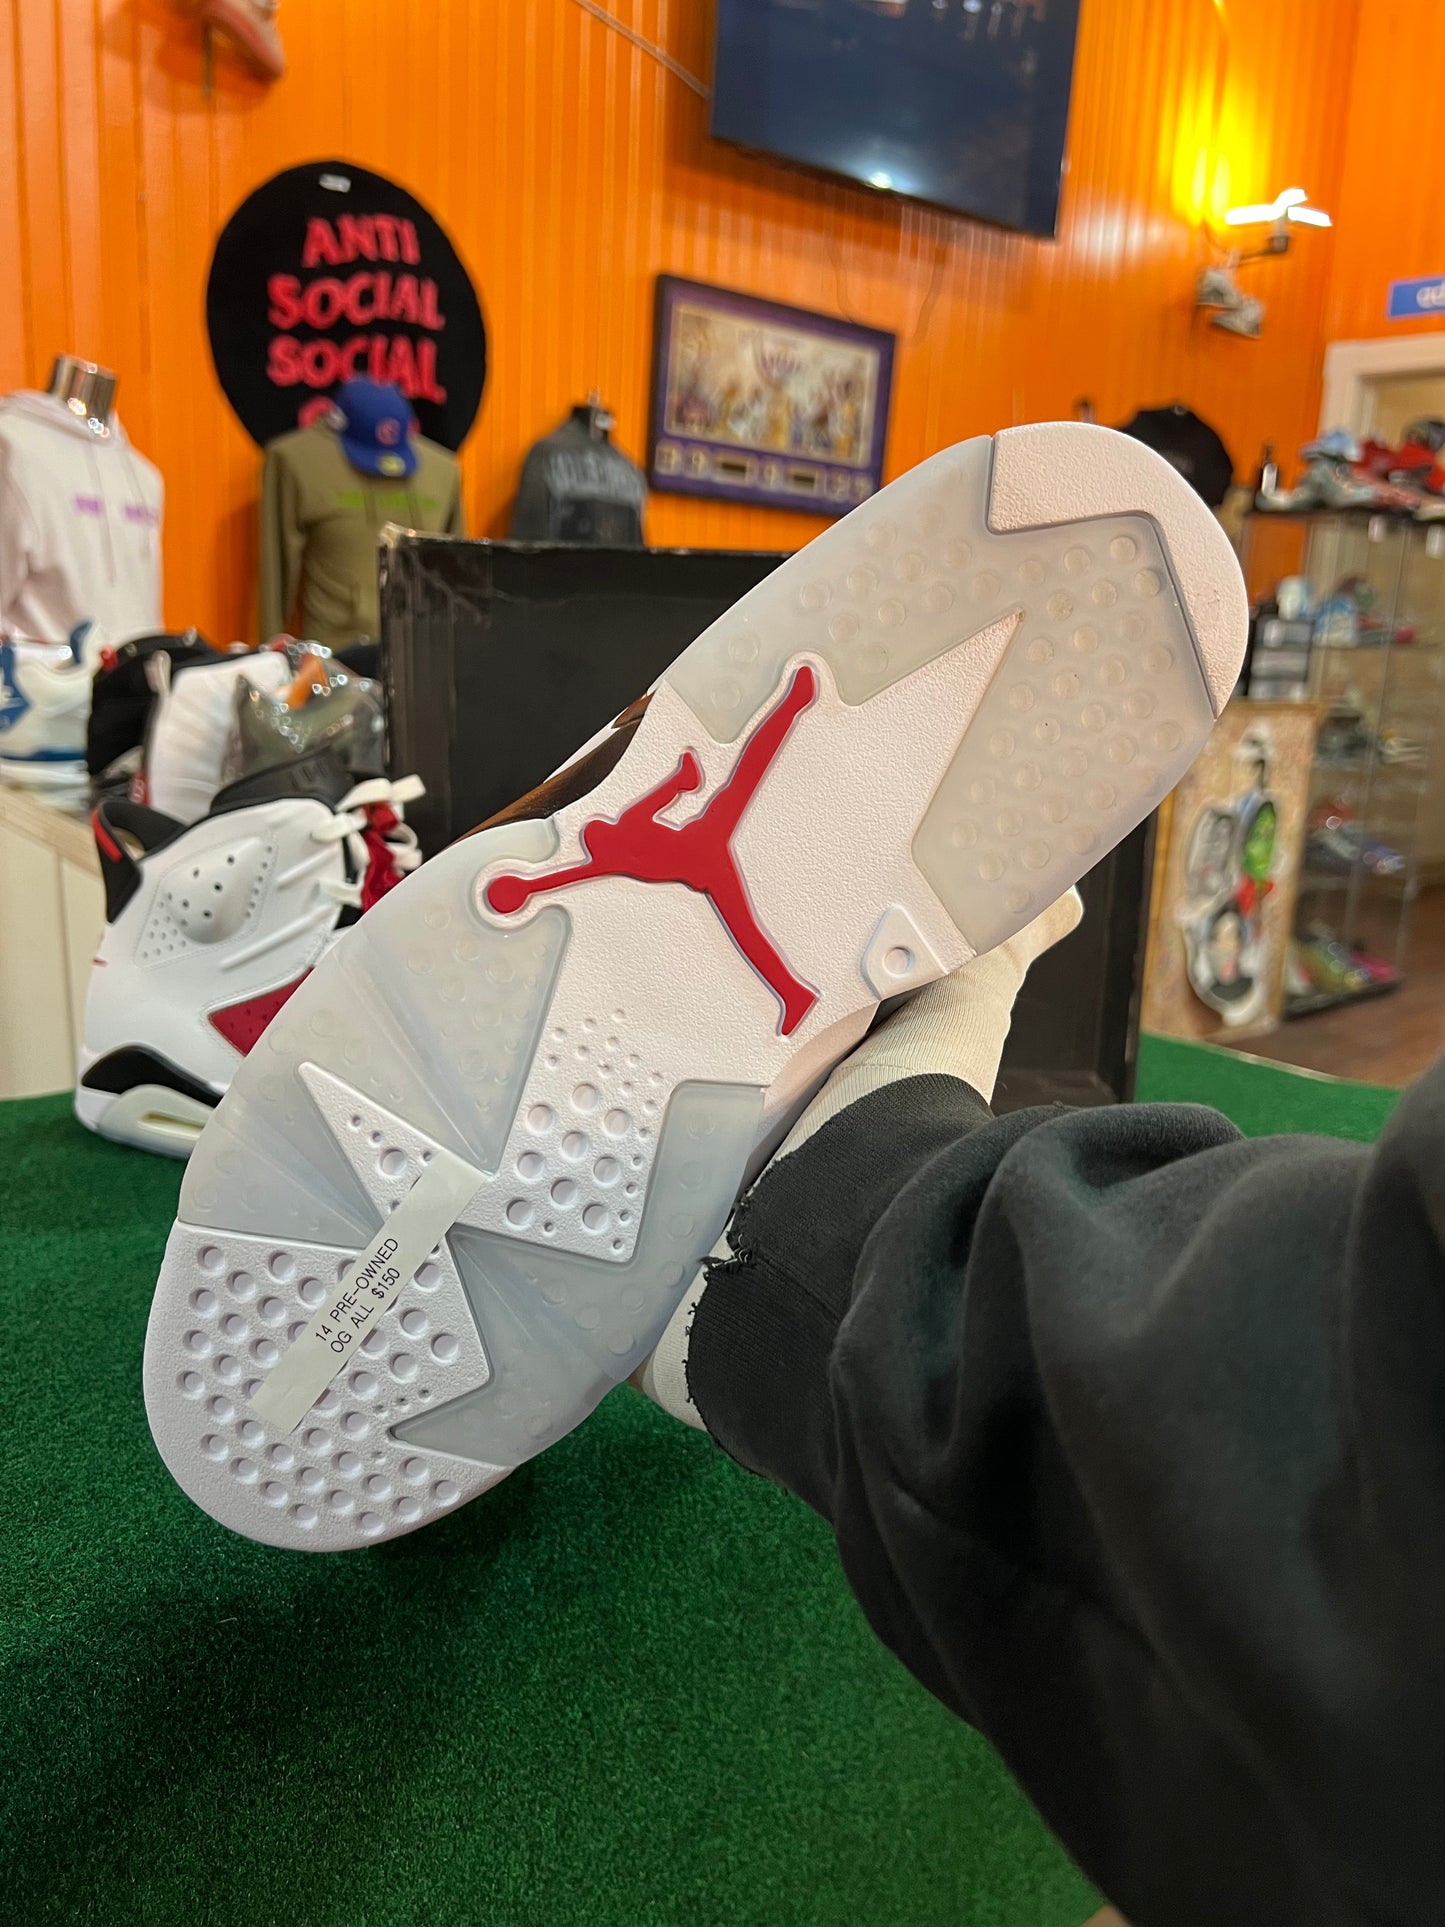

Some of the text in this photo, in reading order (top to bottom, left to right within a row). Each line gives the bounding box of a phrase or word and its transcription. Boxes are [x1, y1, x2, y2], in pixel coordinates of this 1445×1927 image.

[303, 213, 420, 267] ANTI
[267, 271, 446, 330] SOCIAL
[266, 334, 447, 404] SOCIAL
[315, 1238, 399, 1342] 14 PRE-OWNED
[330, 1267, 400, 1353] OG ALL $150
